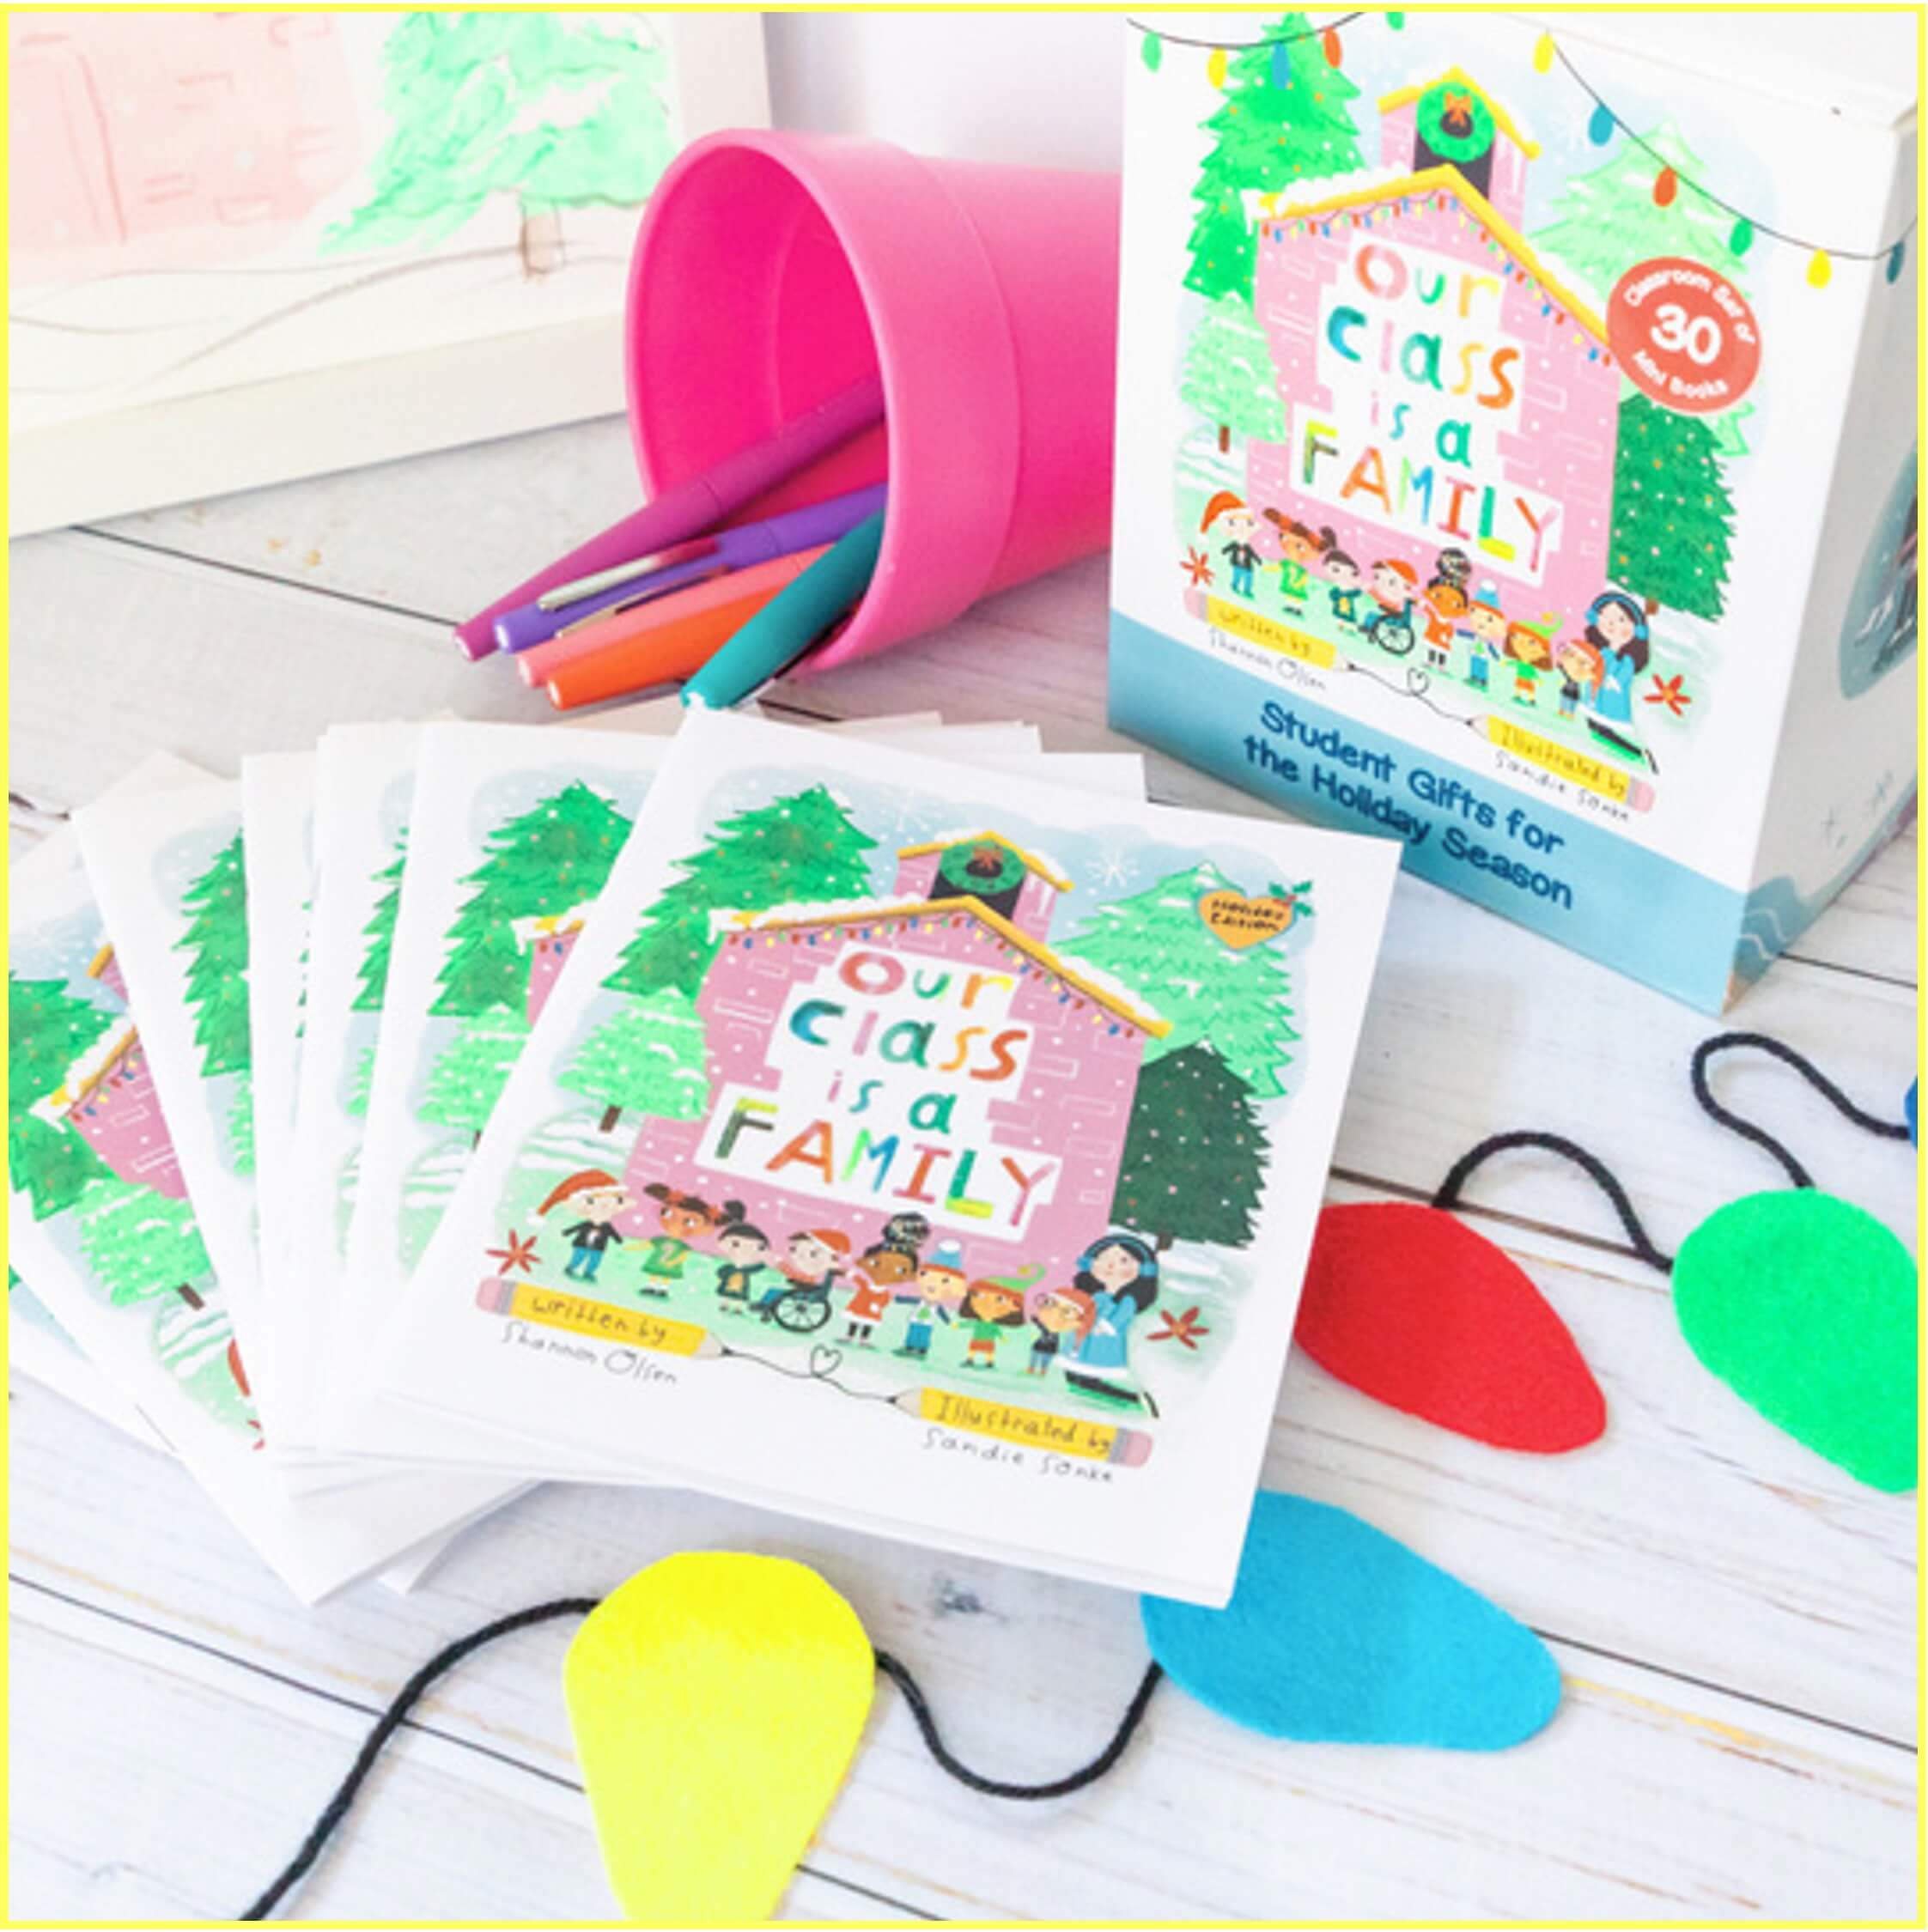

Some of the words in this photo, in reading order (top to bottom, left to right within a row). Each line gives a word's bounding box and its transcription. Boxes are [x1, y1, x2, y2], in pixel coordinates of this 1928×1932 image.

[1354, 245, 1499, 318] Our
[1624, 270, 1712, 307] Classroom
[1712, 285, 1745, 318] Set
[1734, 323, 1756, 345] of
[1650, 303, 1722, 367] 30
[1633, 349, 1668, 385] Mini
[1670, 376, 1728, 398] Books
[1371, 392, 1410, 440] is
[1435, 420, 1472, 468] a
[1303, 420, 1560, 572] FAMILY
[1291, 633, 1310, 657] by
[1261, 700, 1396, 783] Student
[1408, 769, 1496, 829] Gifts
[1505, 809, 1565, 854] for
[1495, 750, 1565, 793] Sandie
[1502, 724, 1603, 781] Illustrated
[1609, 775, 1625, 797] by
[1244, 735, 1299, 782] the
[1311, 764, 1432, 846] Holiday
[1442, 826, 1573, 910] Season
[838, 951, 1014, 1009] Our
[828, 1071, 882, 1115] is
[909, 1092, 958, 1134] a
[715, 1097, 1057, 1226] FAMILY
[502, 1321, 599, 1364] Shannon
[604, 1349, 678, 1384] Olsen
[637, 1319, 667, 1346] by
[923, 1427, 1024, 1465] Sandie
[1040, 1455, 1112, 1483] Sonke
[937, 1394, 1078, 1443] Illustrated
[1087, 1431, 1110, 1455] by
